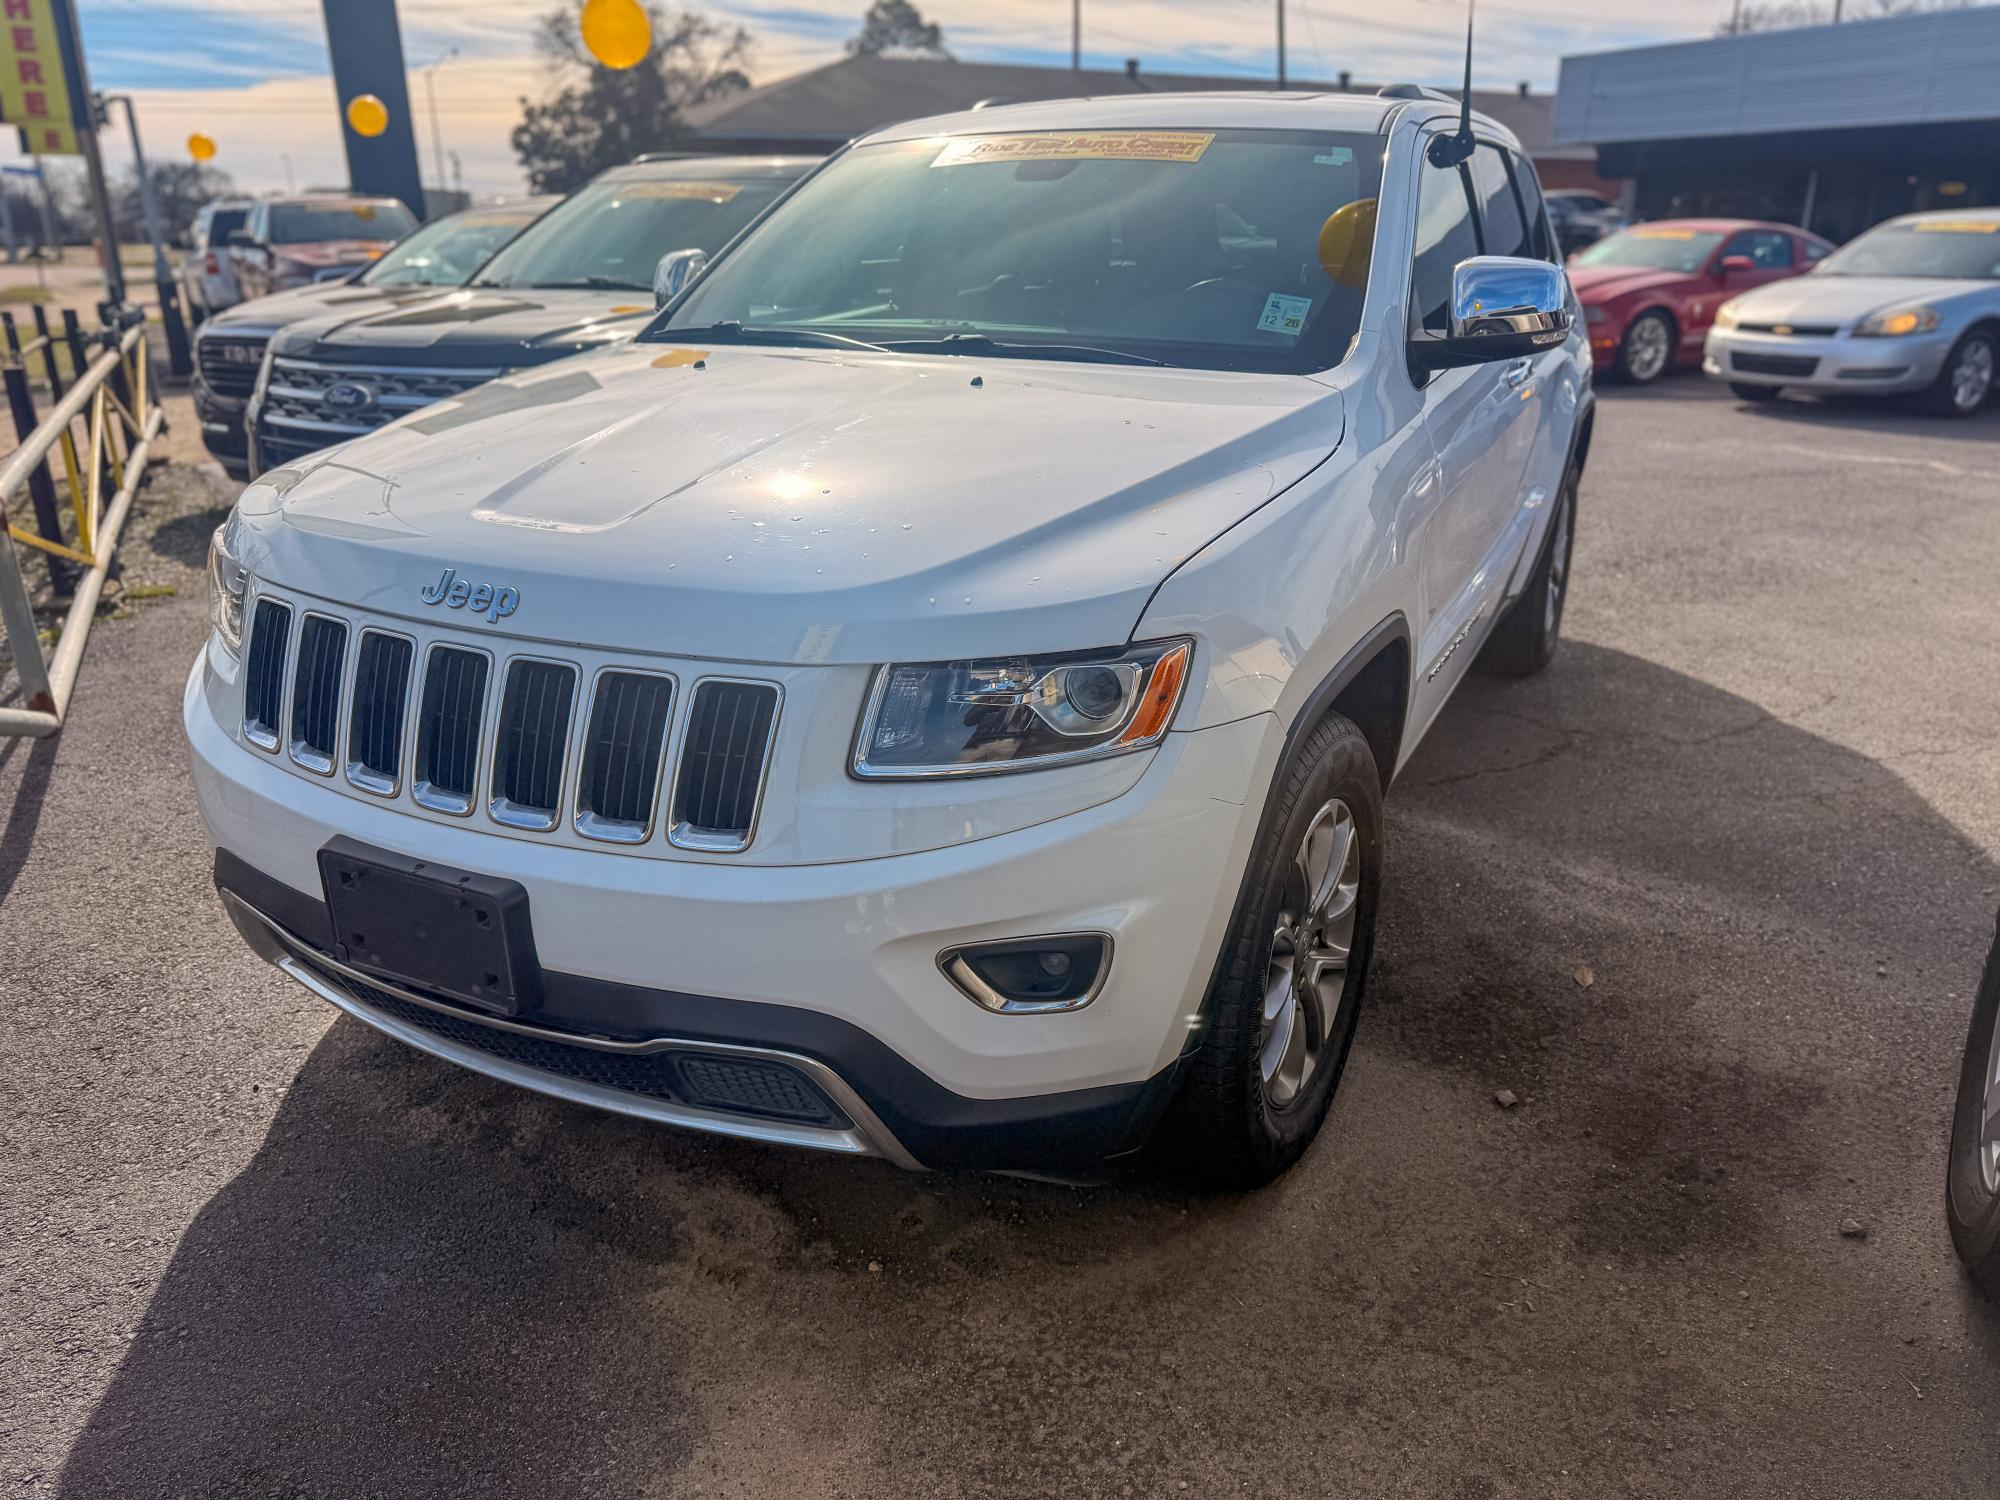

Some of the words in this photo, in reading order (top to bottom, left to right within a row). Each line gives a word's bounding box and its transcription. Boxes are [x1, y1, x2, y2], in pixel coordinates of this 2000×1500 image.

[4, 0, 47, 115] HERE
[1068, 138, 1123, 149] AUTO
[1264, 314, 1278, 325] 12
[328, 387, 358, 405] Ford
[421, 567, 521, 625] Jeep
